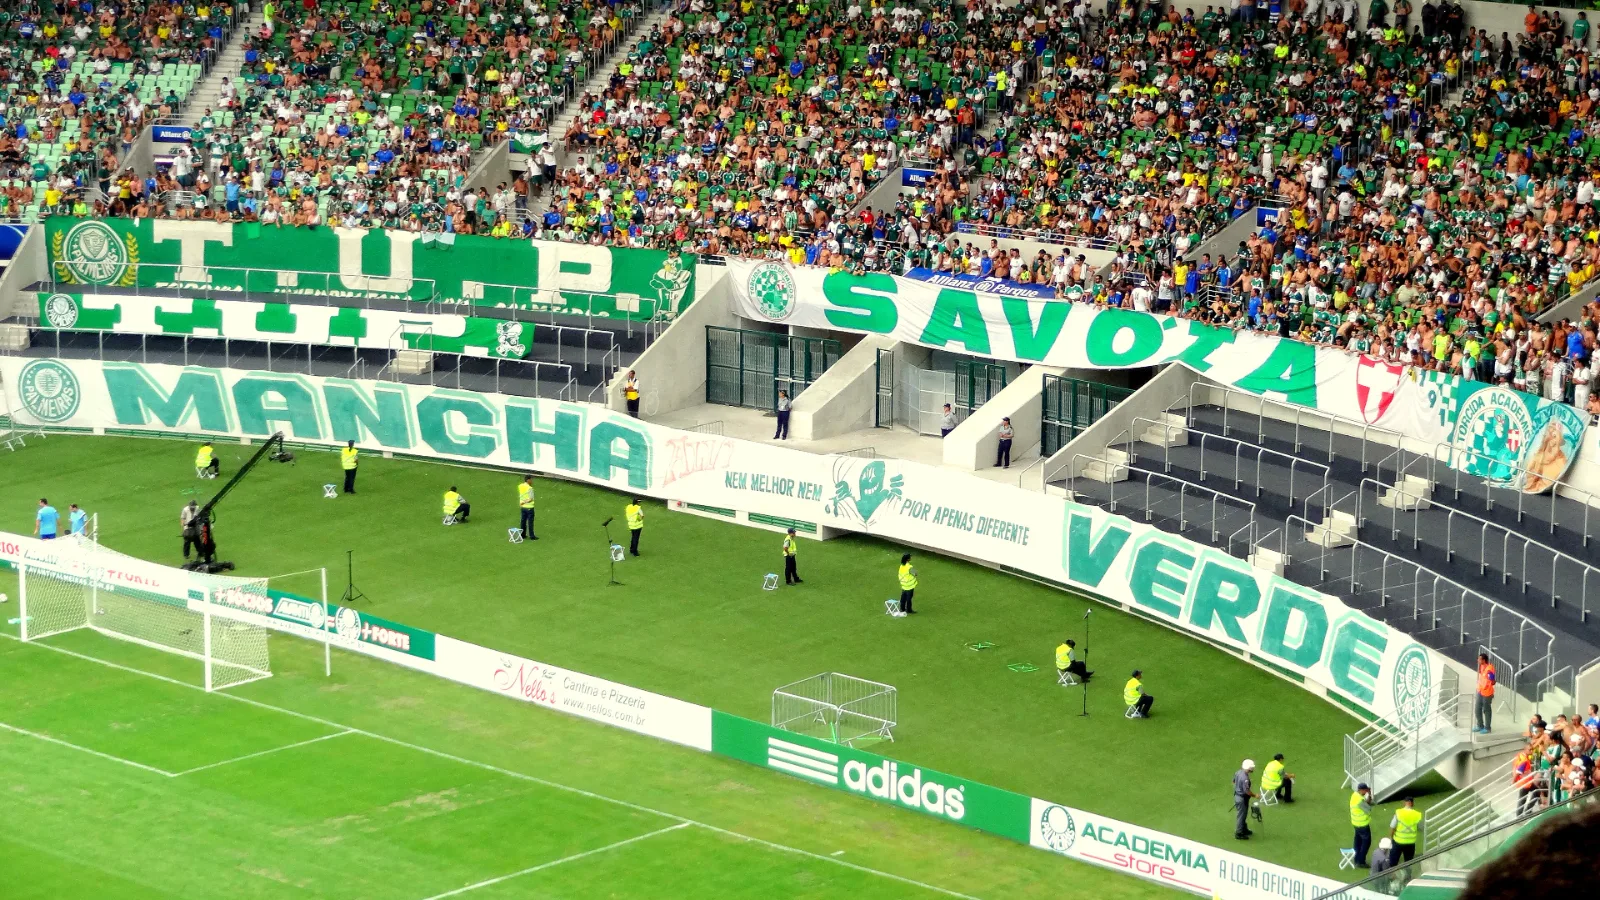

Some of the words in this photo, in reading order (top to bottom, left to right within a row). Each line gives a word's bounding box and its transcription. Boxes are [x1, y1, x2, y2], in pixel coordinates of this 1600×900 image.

[71, 248, 119, 279] PALMEIRAS
[925, 274, 976, 290] Allianz
[992, 283, 1039, 298] Parque
[25, 385, 75, 417] PALMEIRAS
[1456, 394, 1486, 443] TORCIDA
[725, 470, 748, 490] NEM
[750, 472, 794, 498] MELHOR
[797, 481, 823, 502] NEM
[103, 360, 654, 493] MANCHA
[1061, 500, 1389, 706] VERDE
[901, 497, 929, 524] PIOR
[932, 505, 975, 533] APENAS
[976, 515, 1030, 547] DIFERENTE
[562, 694, 647, 728] www.nellos.com.br
[563, 676, 600, 698] Cantina
[600, 688, 607, 700] e
[608, 688, 647, 711] Pizzeria
[843, 759, 965, 820] adidas
[1081, 821, 1211, 874] ACADEMIA
[1113, 852, 1176, 878] store
[1218, 859, 1228, 879] A
[1230, 861, 1259, 889] LOJA
[1262, 871, 1306, 900] OFICIAL
